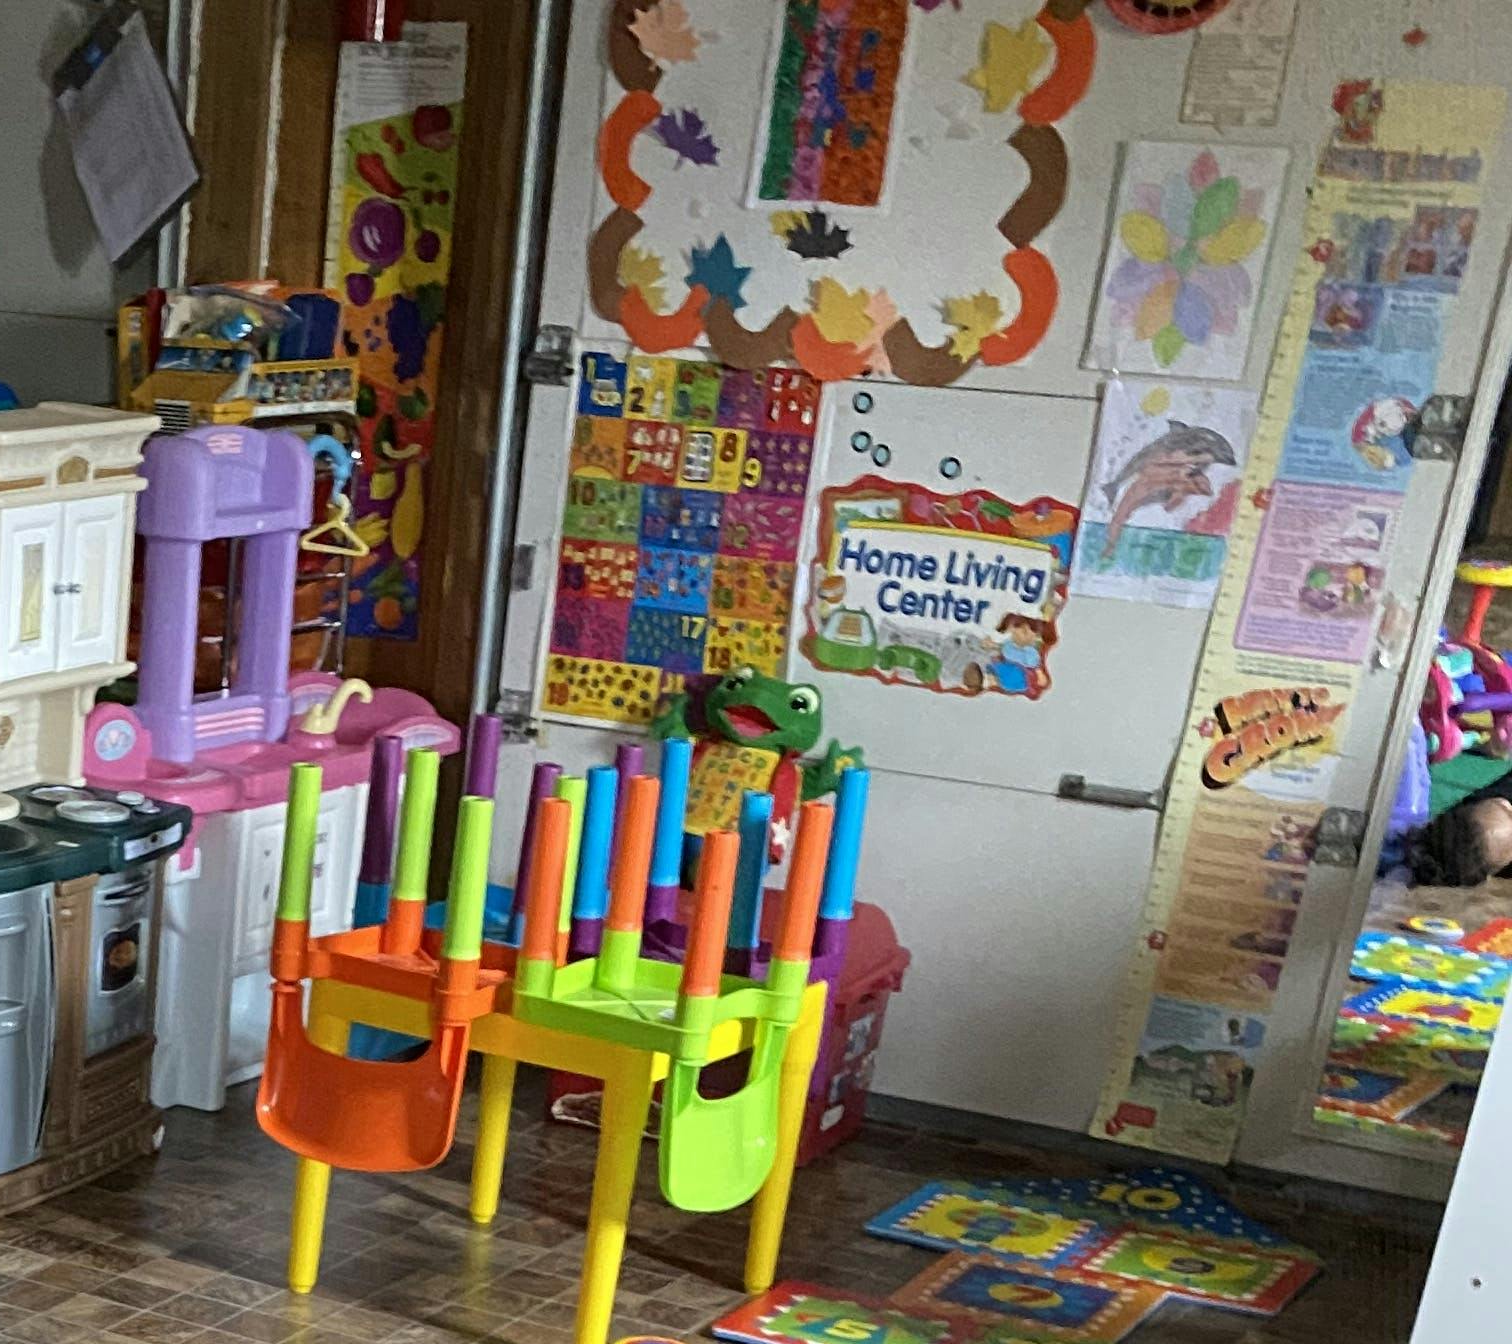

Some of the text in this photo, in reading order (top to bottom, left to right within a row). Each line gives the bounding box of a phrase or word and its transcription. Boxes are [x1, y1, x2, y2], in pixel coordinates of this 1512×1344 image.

[627, 386, 645, 413] 2
[720, 431, 739, 463] 8
[742, 456, 762, 489] 9
[838, 537, 1047, 604] Home Living
[876, 580, 992, 624] Center
[681, 615, 708, 640] 17
[1098, 1183, 1183, 1212] 10
[823, 1318, 881, 1341] 5
